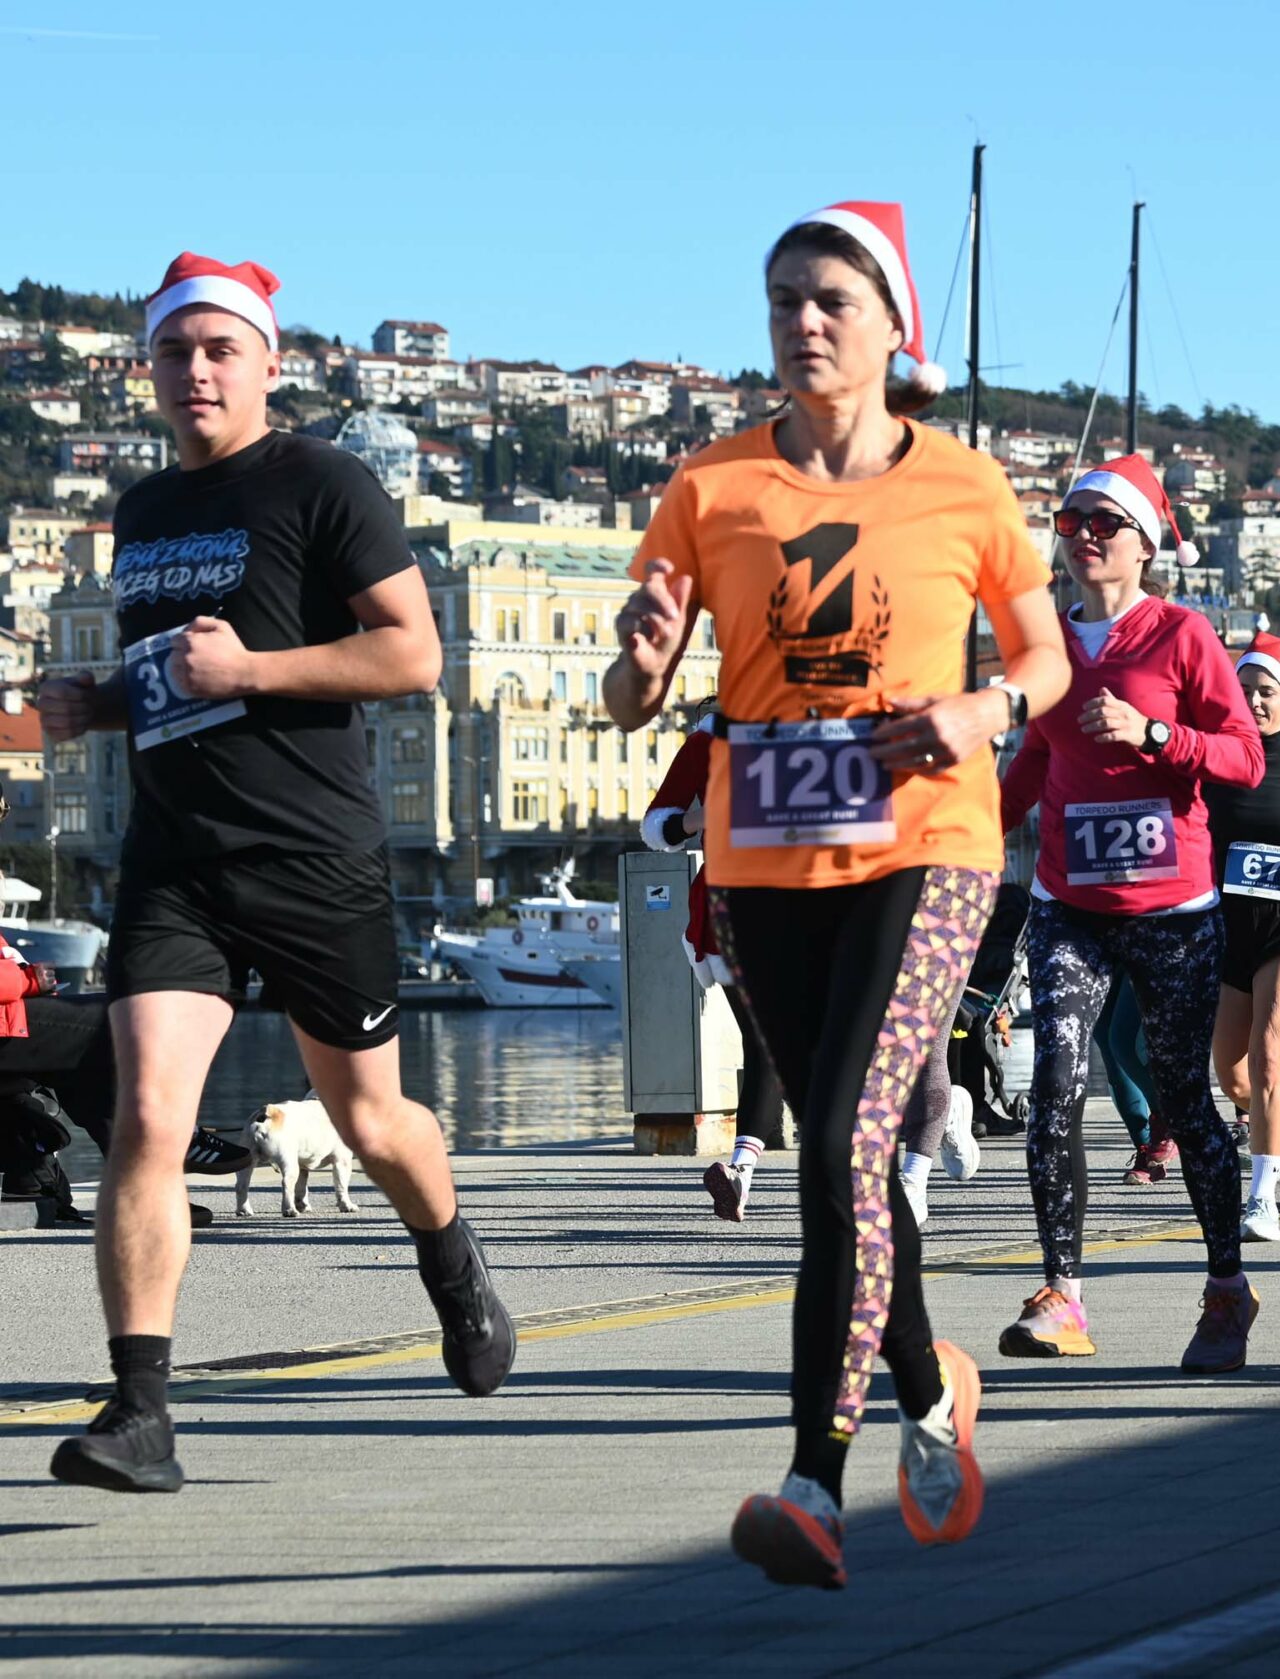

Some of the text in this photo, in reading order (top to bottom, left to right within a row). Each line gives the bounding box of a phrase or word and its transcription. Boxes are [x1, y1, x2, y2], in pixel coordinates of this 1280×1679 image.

[193, 562, 238, 590] NAS
[746, 745, 878, 808] 120
[1074, 801, 1162, 815] TORPEDO RUNNERS
[1075, 816, 1167, 859] 128
